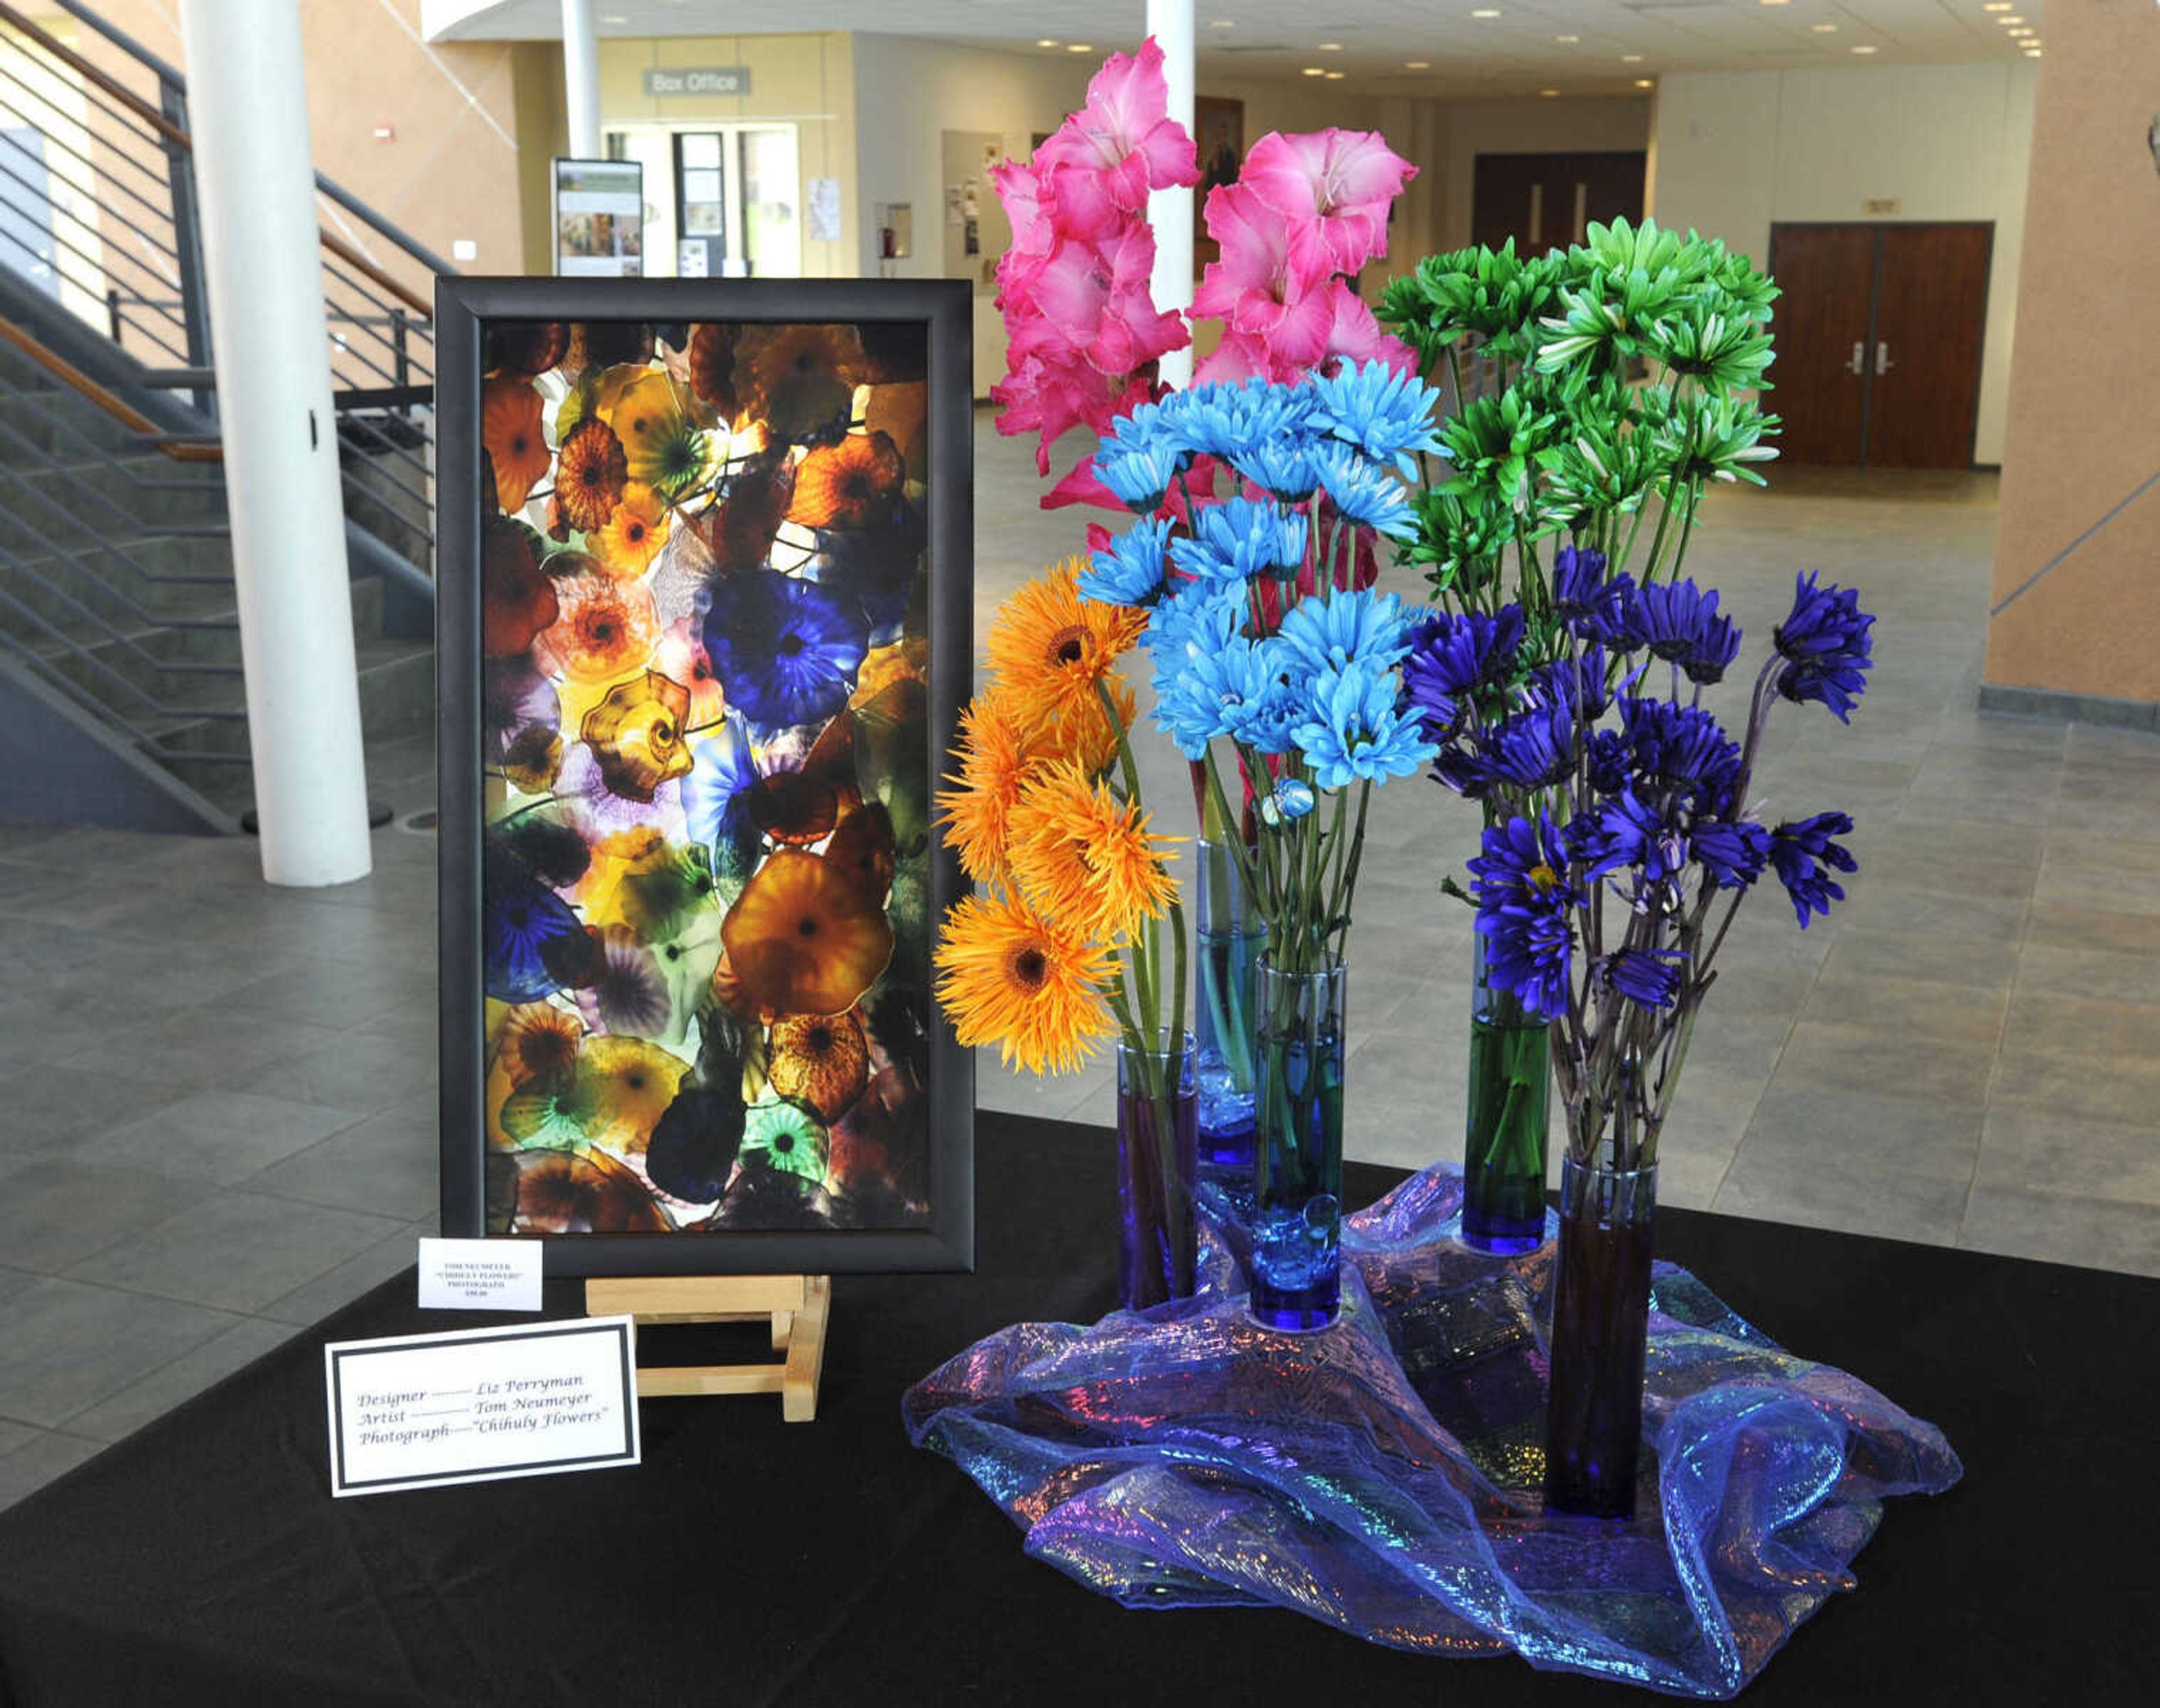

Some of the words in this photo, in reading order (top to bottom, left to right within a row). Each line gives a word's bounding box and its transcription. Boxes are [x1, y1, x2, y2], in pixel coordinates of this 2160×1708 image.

[652, 73, 684, 92] Box
[687, 72, 739, 92] Office
[357, 1391, 428, 1408] Designer
[476, 1382, 500, 1396] Liz
[505, 1374, 584, 1394] Perryman
[357, 1411, 404, 1425] Artist
[475, 1401, 507, 1414] Tom
[512, 1394, 592, 1410] Neumeyer
[359, 1423, 449, 1445] Photograph
